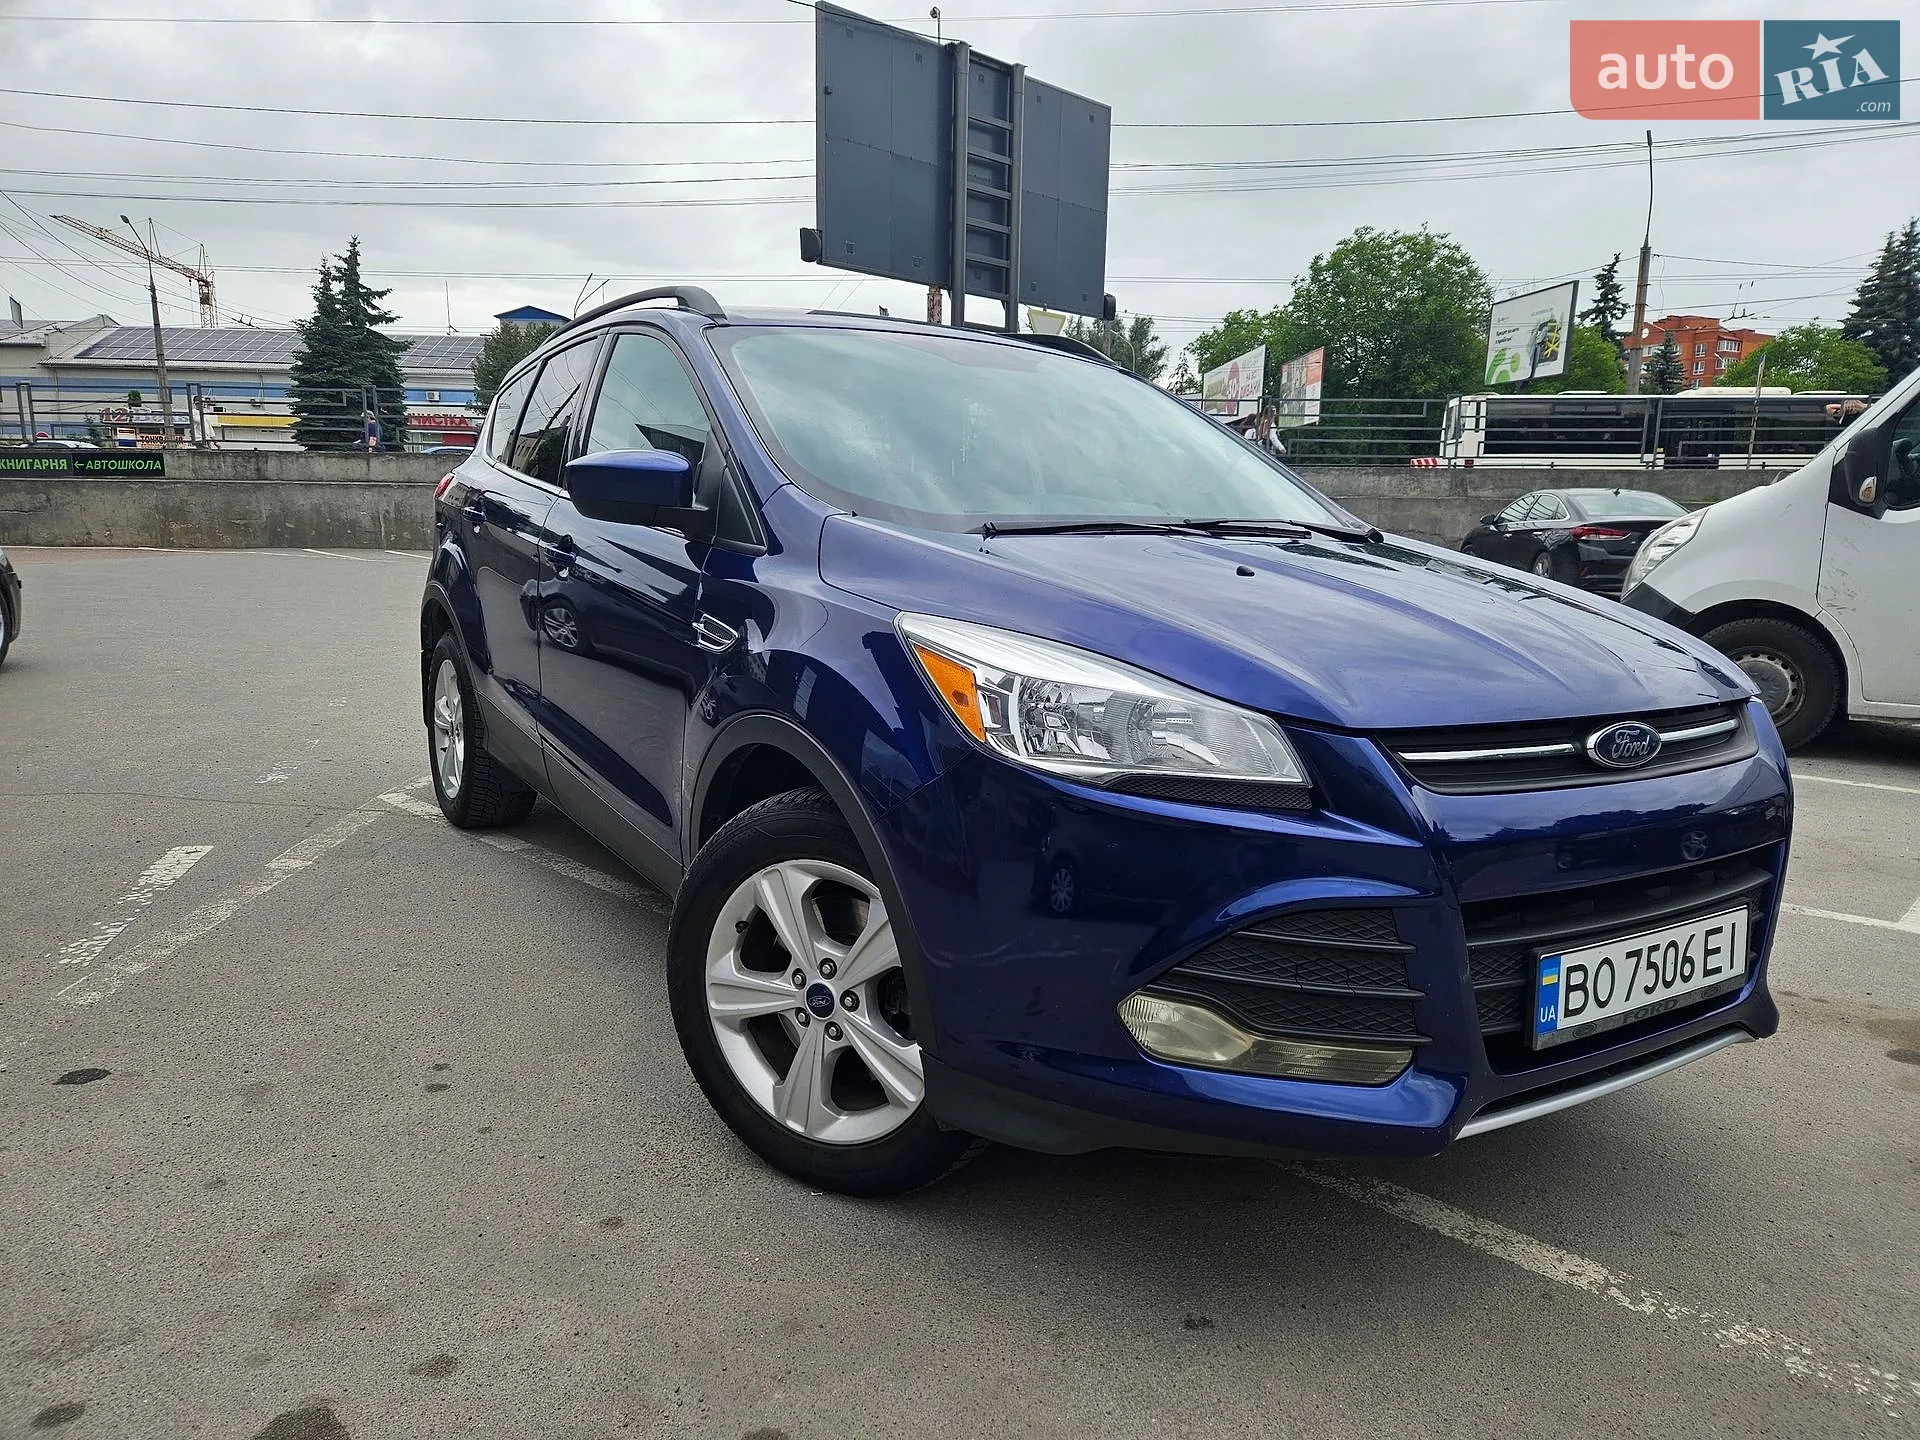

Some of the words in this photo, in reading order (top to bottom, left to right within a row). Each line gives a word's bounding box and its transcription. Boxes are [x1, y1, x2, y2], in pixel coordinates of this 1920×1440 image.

[100, 407, 129, 422] 12
[0, 458, 67, 470] КНИГАРНЯ
[85, 460, 162, 470] АВТОШКОЛА
[1611, 729, 1650, 759] Ford
[1563, 956, 1616, 1018] BO
[1624, 933, 1696, 1003] 7506
[1702, 921, 1737, 979] EI
[1540, 1004, 1556, 1023] UA
[1622, 999, 1679, 1024] FORD
